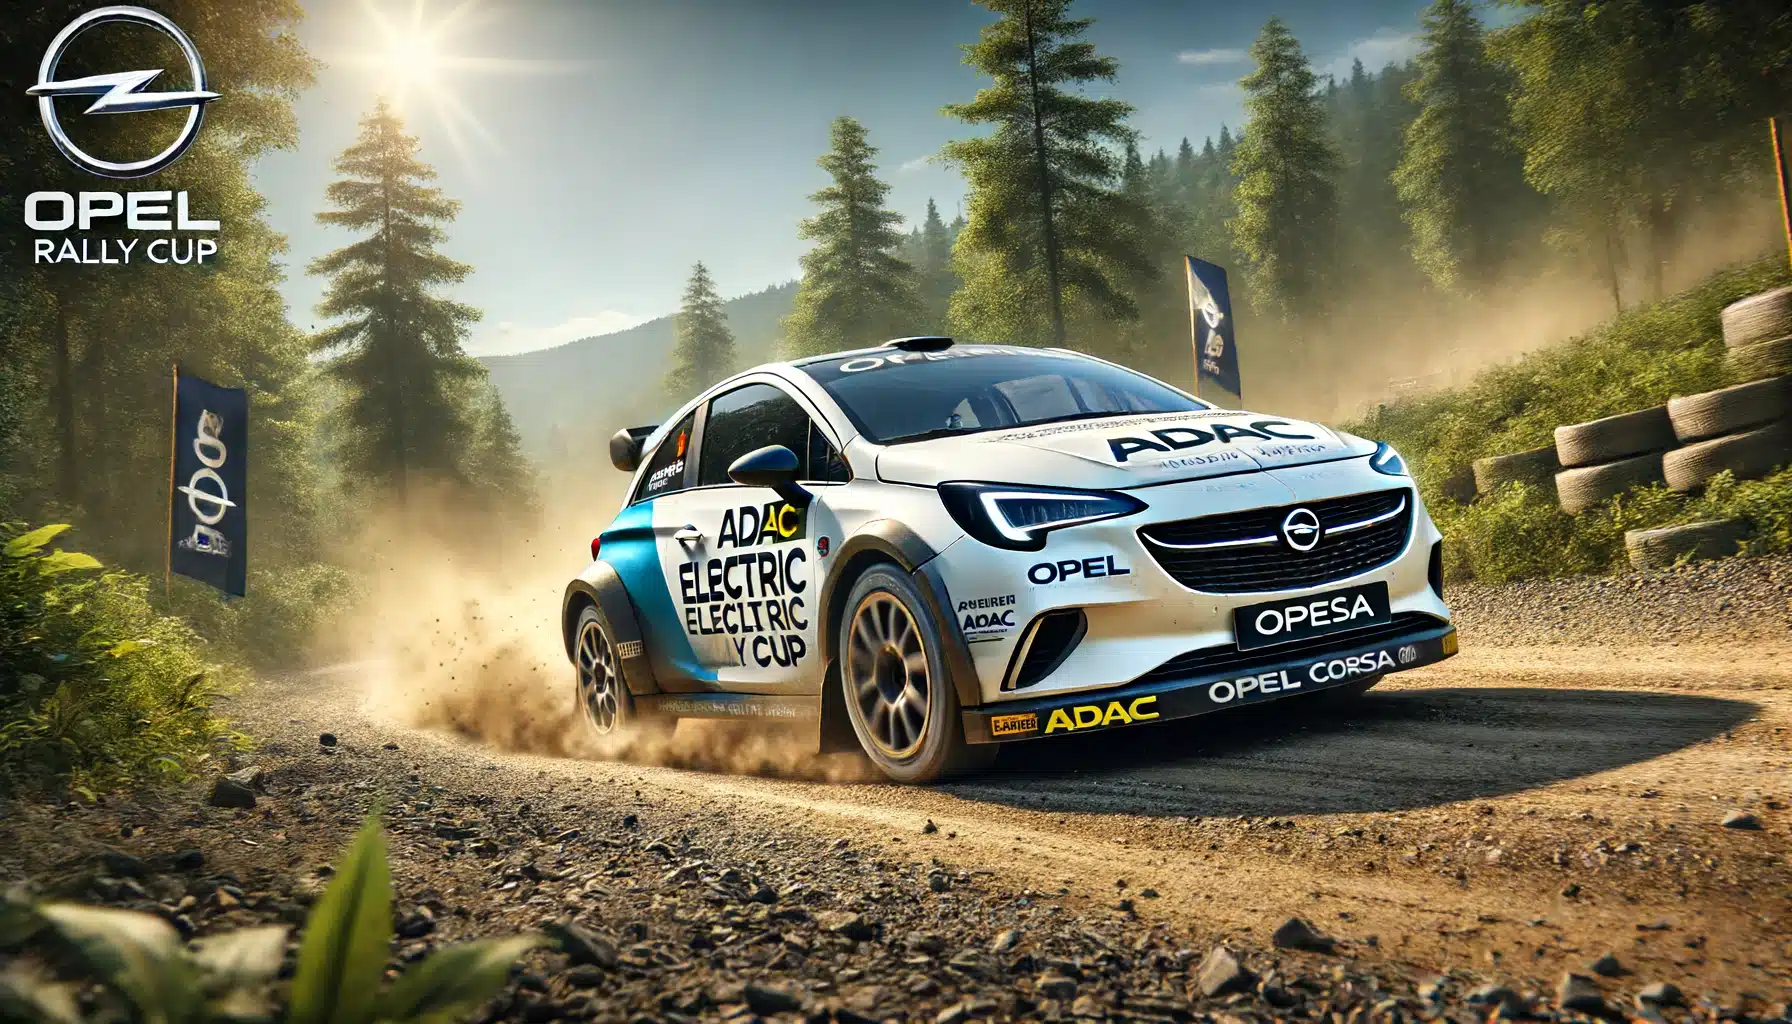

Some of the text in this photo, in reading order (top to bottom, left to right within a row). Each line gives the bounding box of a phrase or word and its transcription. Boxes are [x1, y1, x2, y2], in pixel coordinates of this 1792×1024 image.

[1107, 420, 1315, 462] ADAC
[717, 503, 798, 549] ADAC
[679, 547, 807, 604] ELECTRIC
[1027, 555, 1130, 585] OPEL
[963, 609, 1016, 630] ADAC
[1255, 594, 1374, 635] OPESA
[752, 634, 807, 668] CUP
[1208, 670, 1301, 703] OPEL
[1309, 650, 1396, 683] CORSA
[1044, 695, 1160, 734] ADAC
